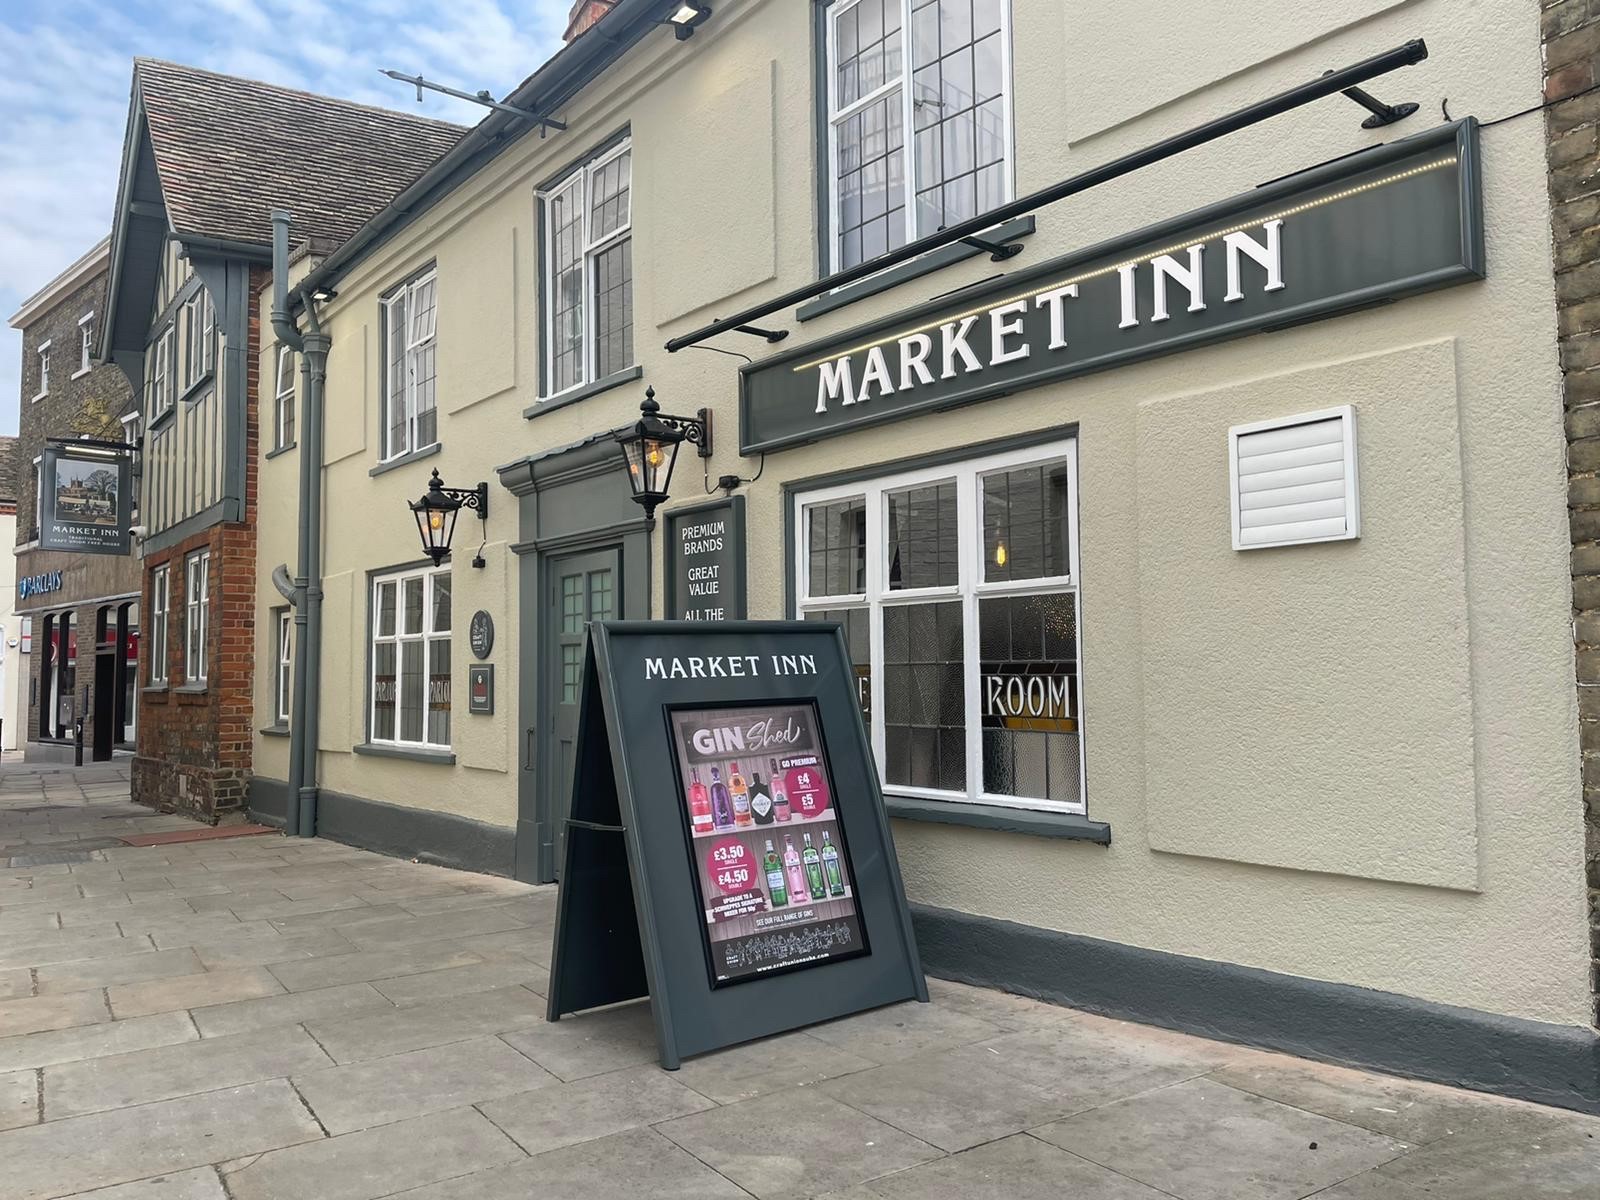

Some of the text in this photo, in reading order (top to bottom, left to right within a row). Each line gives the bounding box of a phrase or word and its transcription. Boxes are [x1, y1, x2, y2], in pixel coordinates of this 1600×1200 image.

[815, 218, 1286, 414] MARKET INN
[52, 525, 119, 537] MARKET INN
[682, 521, 725, 540] PREMIUM
[684, 537, 723, 555] BRANDS
[688, 565, 720, 581] GREAT
[27, 569, 62, 595] BARCLAYS
[689, 581, 720, 596] VALUE
[685, 607, 725, 621] ALL THE
[645, 654, 819, 680] MARKET INN
[987, 675, 1071, 719] ROOM
[692, 717, 801, 755] GIN Shed
[781, 756, 818, 768] GO PREMIUM
[797, 772, 811, 786] £4
[801, 793, 814, 806] £5
[722, 894, 743, 905] UPGRADE
[756, 918, 765, 927] SEE
[765, 916, 774, 925] OUR
[774, 915, 784, 923] FULL
[783, 912, 798, 921] RANGE
[797, 911, 803, 919] OF
[803, 909, 814, 918] GINS
